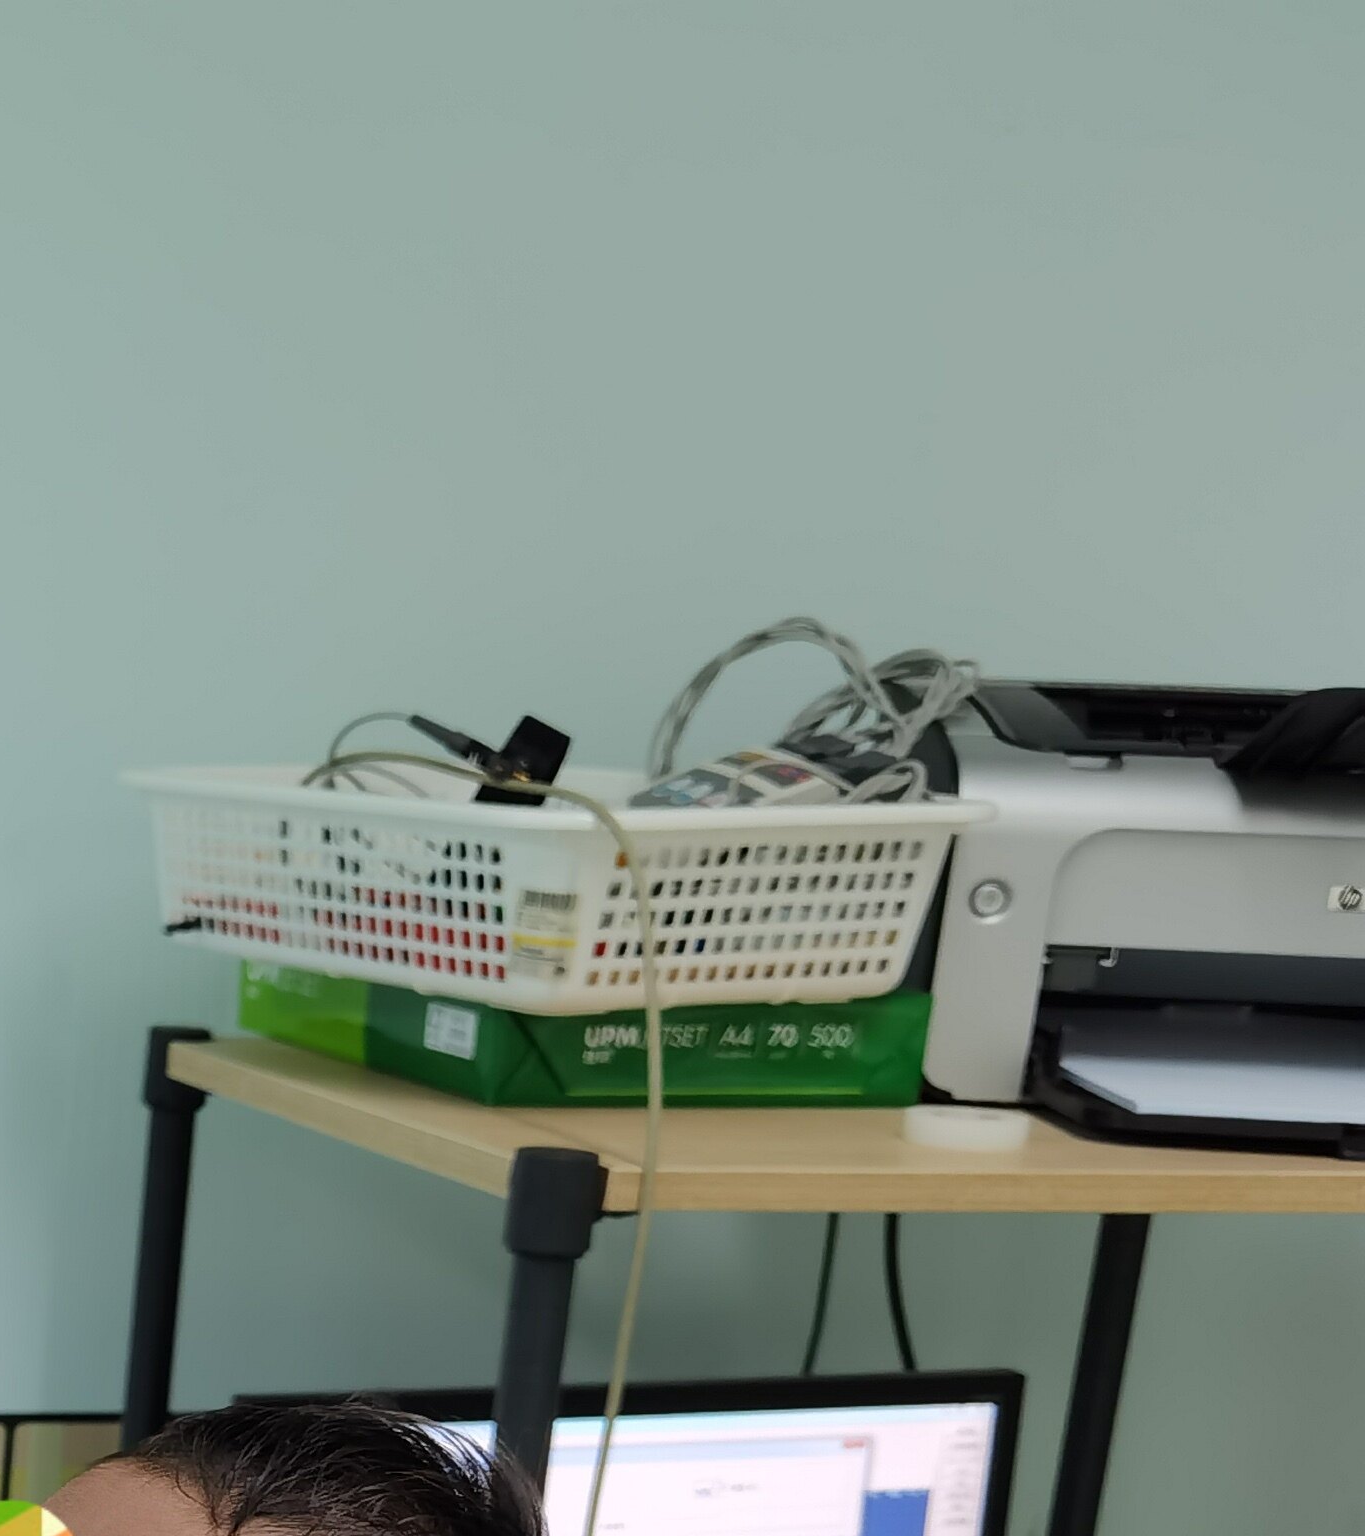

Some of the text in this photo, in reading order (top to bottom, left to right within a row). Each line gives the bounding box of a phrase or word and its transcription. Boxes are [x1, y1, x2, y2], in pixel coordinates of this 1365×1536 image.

[1338, 885, 1362, 910] hp
[584, 1025, 639, 1048] UPM
[719, 1024, 754, 1046] A4
[767, 1024, 799, 1048] 70
[808, 1023, 855, 1048] 500
